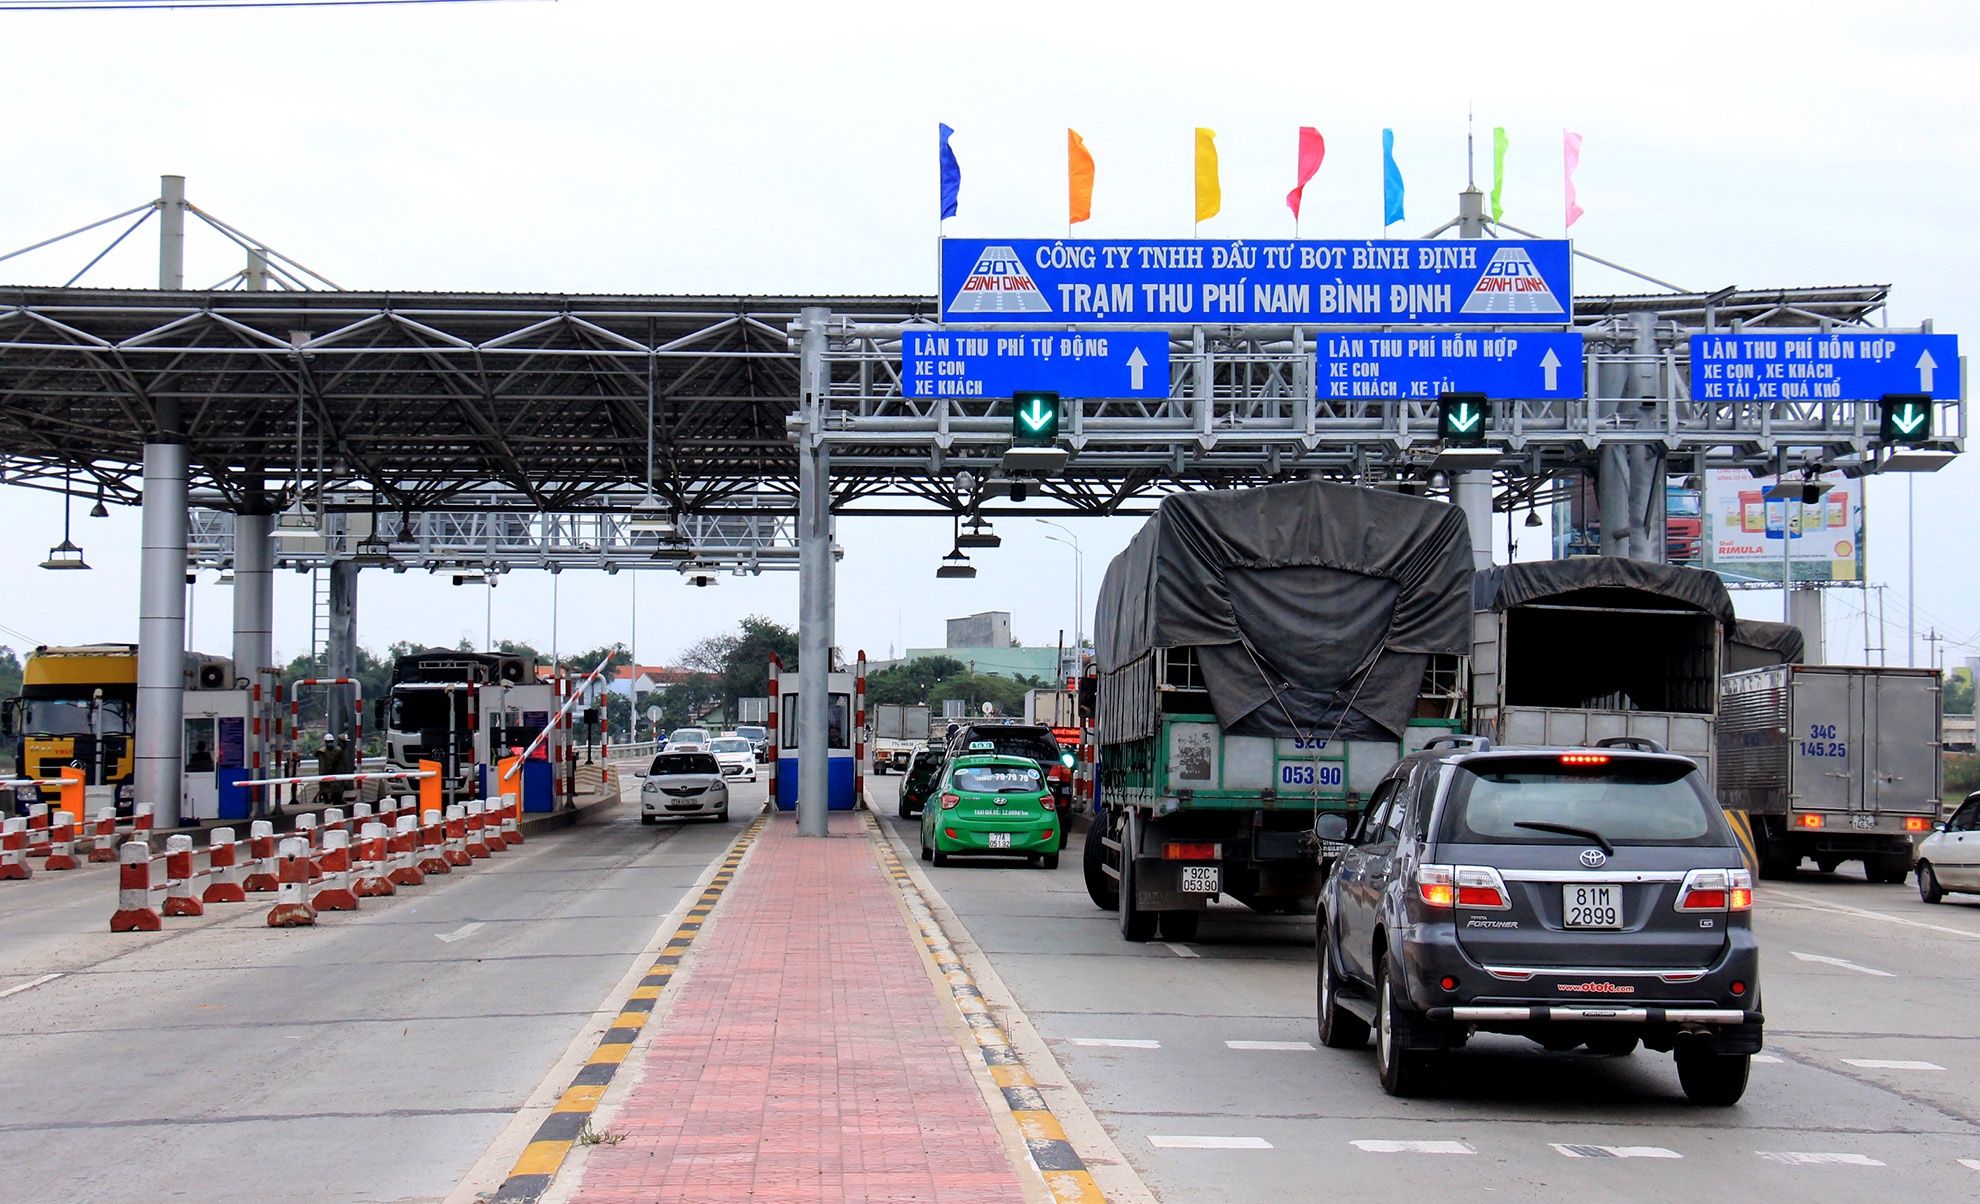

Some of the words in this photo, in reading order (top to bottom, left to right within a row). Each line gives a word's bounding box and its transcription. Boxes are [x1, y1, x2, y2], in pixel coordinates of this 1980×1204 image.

[1036, 240, 1096, 269] CÔNG
[1102, 246, 1134, 269] TY
[1138, 246, 1204, 269] TNHH
[1211, 239, 1257, 269] ĐẦU
[1263, 243, 1295, 269] TƯ
[1300, 247, 1347, 269] BOT
[1352, 240, 1410, 270] BÌNH
[1418, 246, 1477, 273] ĐỊNH
[974, 260, 1021, 275] BOT
[1485, 261, 1533, 276] BOT
[964, 276, 1001, 291] BINH
[1476, 277, 1513, 292] BINH
[1057, 283, 1134, 319] TRẠM
[1141, 283, 1193, 313] THU
[1203, 277, 1246, 313] PHÍ
[1254, 284, 1310, 314] NAM
[1320, 278, 1380, 314] BÌNH
[1390, 284, 1451, 319] ĐỊNH
[915, 333, 950, 356] LÀN
[956, 337, 989, 356] THU
[997, 334, 1025, 357] PHÍ
[1031, 336, 1054, 361] TỰ
[1060, 335, 1108, 361] ĐỘNG
[1329, 336, 1364, 357] LÀN
[1370, 339, 1402, 357] THU
[1408, 335, 1436, 357] PHÍ
[1442, 333, 1478, 358] HỖN
[1483, 337, 1518, 361] HỢP
[1703, 337, 1738, 359] LÀN
[1744, 341, 1777, 359] THU
[1785, 337, 1813, 359] PHÍ
[1818, 334, 1855, 359] HỖN
[1860, 338, 1896, 363] HỢP
[915, 361, 933, 375] XE
[938, 361, 965, 375] CON
[1330, 362, 1348, 377] XE
[1352, 362, 1379, 377] CON
[1704, 364, 1721, 378] XE
[1766, 364, 1784, 378] XE
[1788, 360, 1834, 378] KHÁCH
[915, 380, 933, 394] XE
[938, 377, 983, 395] KHÁCH
[1330, 381, 1348, 396] XE
[1410, 381, 1428, 395] XE
[1705, 383, 1722, 397] XE
[1727, 378, 1749, 397] TẢI
[1781, 379, 1809, 399] QUÁ
[1718, 546, 1764, 555] RIMULA
[1810, 724, 1837, 739] 34C
[1800, 742, 1846, 758] 145.25
[1282, 766, 1341, 785] 053.90
[1191, 868, 1210, 879] 92C
[1183, 880, 1217, 892] 053.90
[1576, 888, 1610, 906] 81M
[1571, 907, 1616, 925] 2899
[1466, 920, 1519, 929] FORTUNER
[1557, 982, 1635, 993] www.otofc.com
